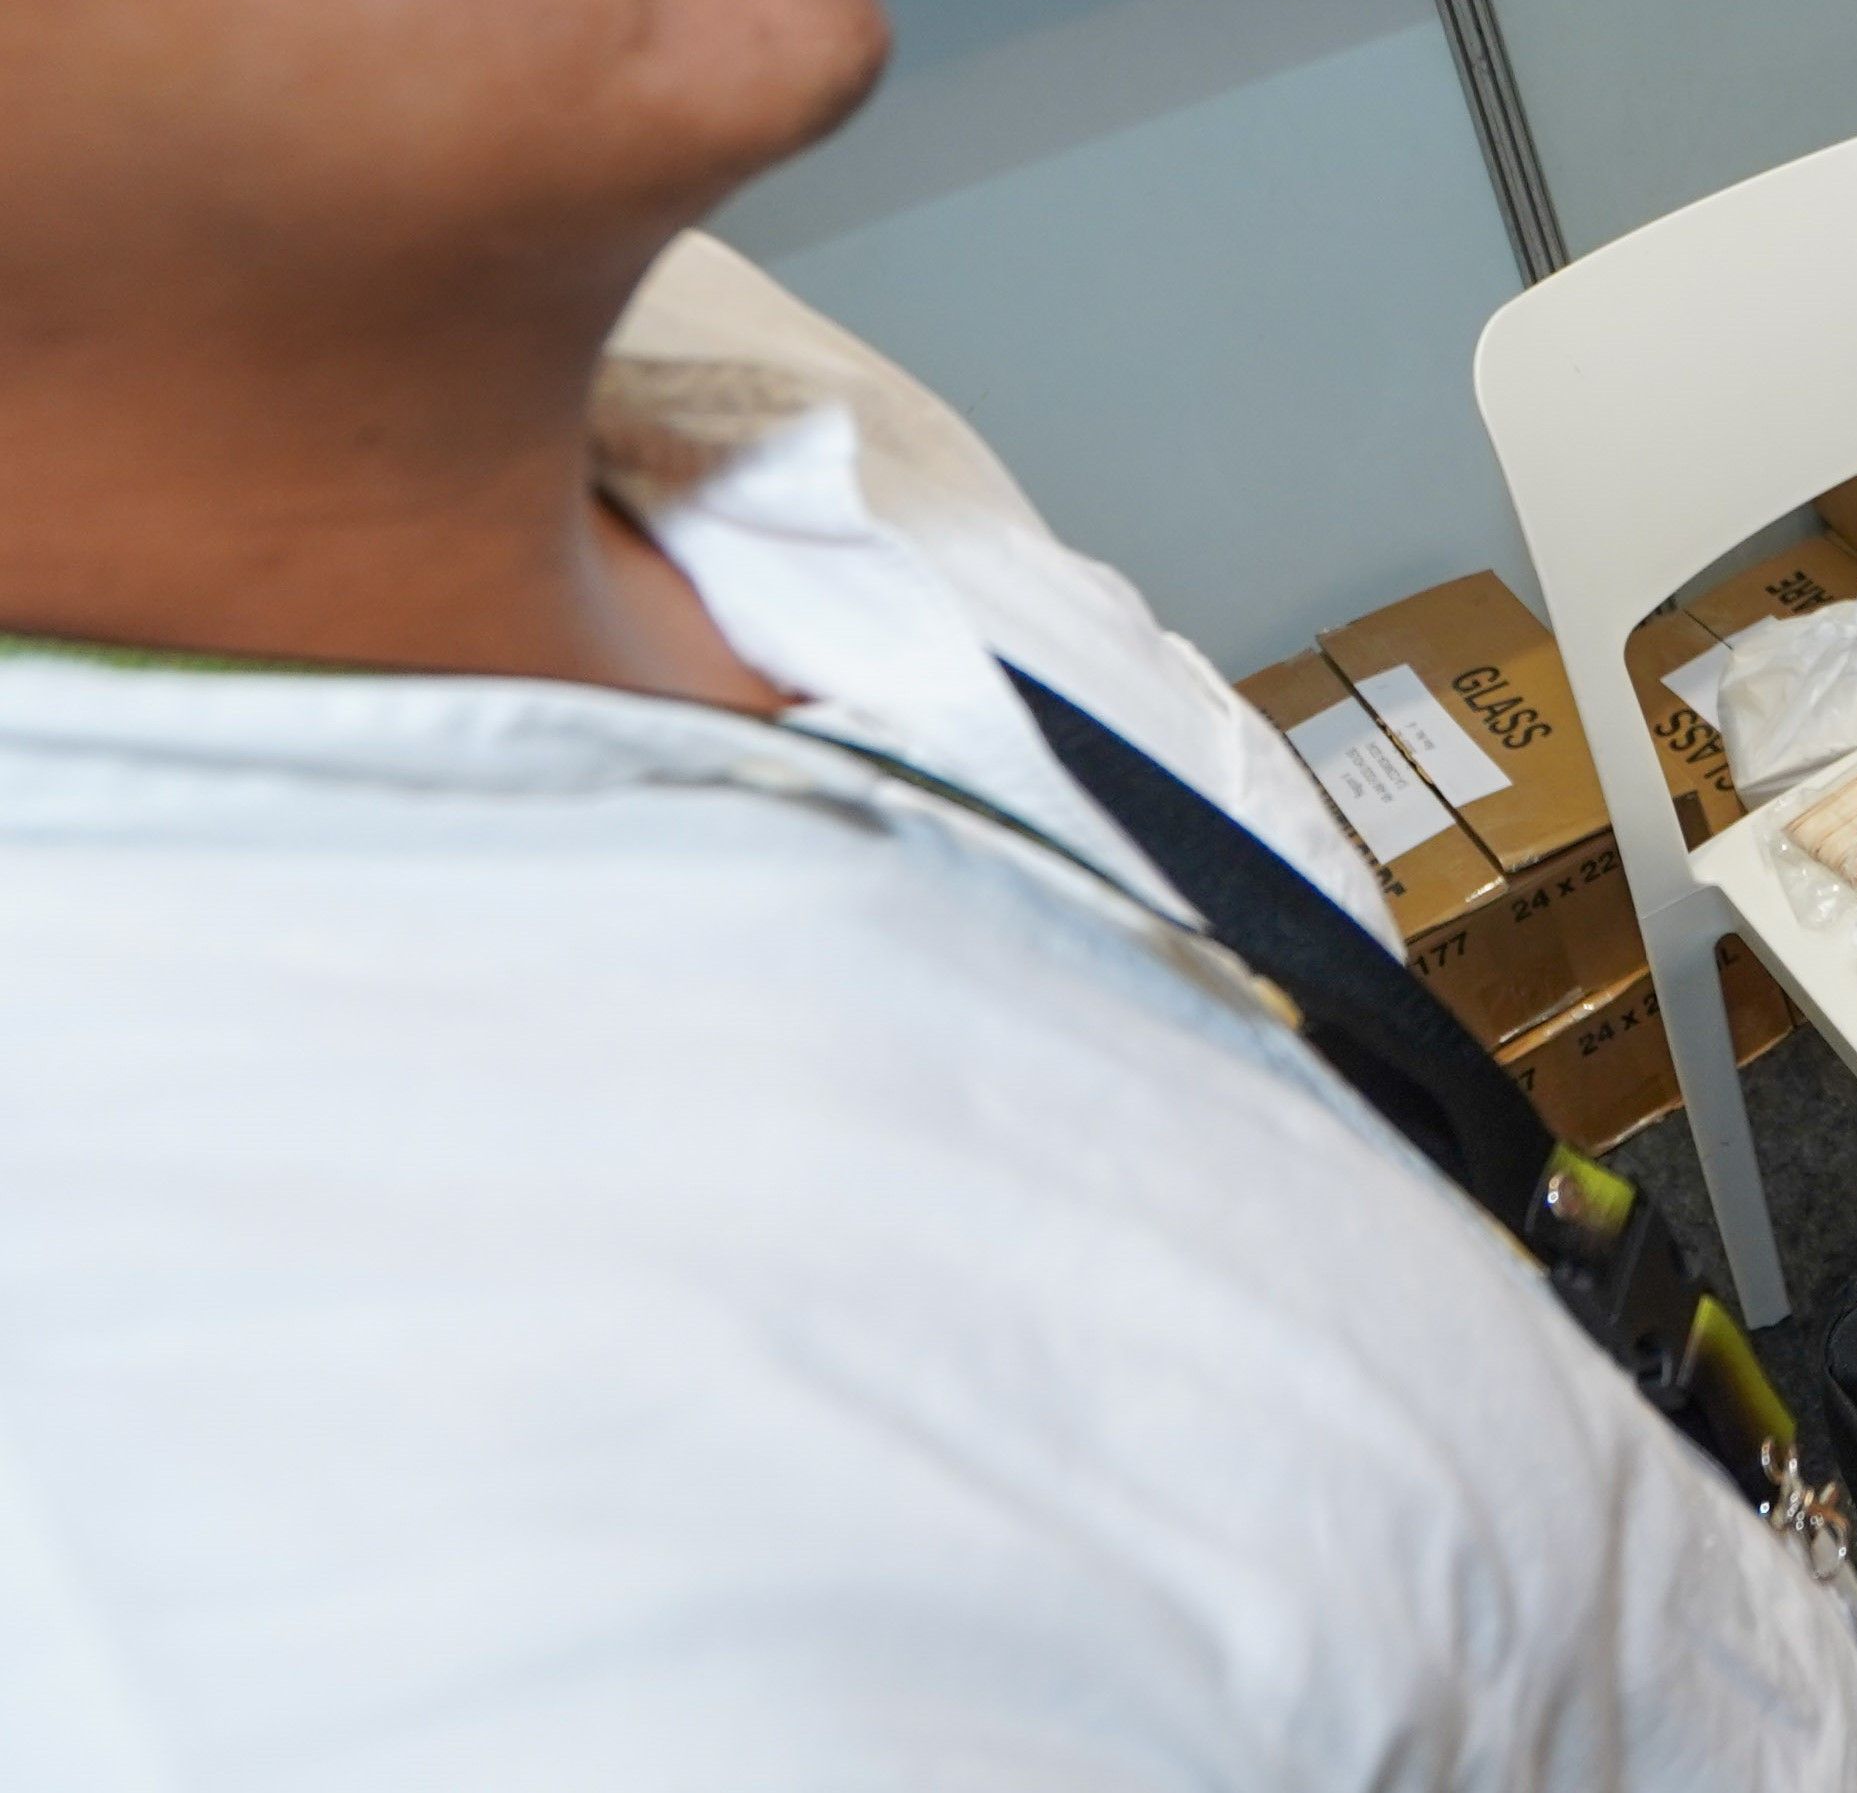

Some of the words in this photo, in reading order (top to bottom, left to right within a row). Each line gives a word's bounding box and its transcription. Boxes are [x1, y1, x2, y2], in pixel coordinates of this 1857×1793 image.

[1452, 665, 1553, 750] GLASS
[1510, 889, 1551, 924] 24
[1556, 878, 1577, 898] x
[1577, 1020, 1616, 1056] 24
[1620, 1010, 1640, 1032] x
